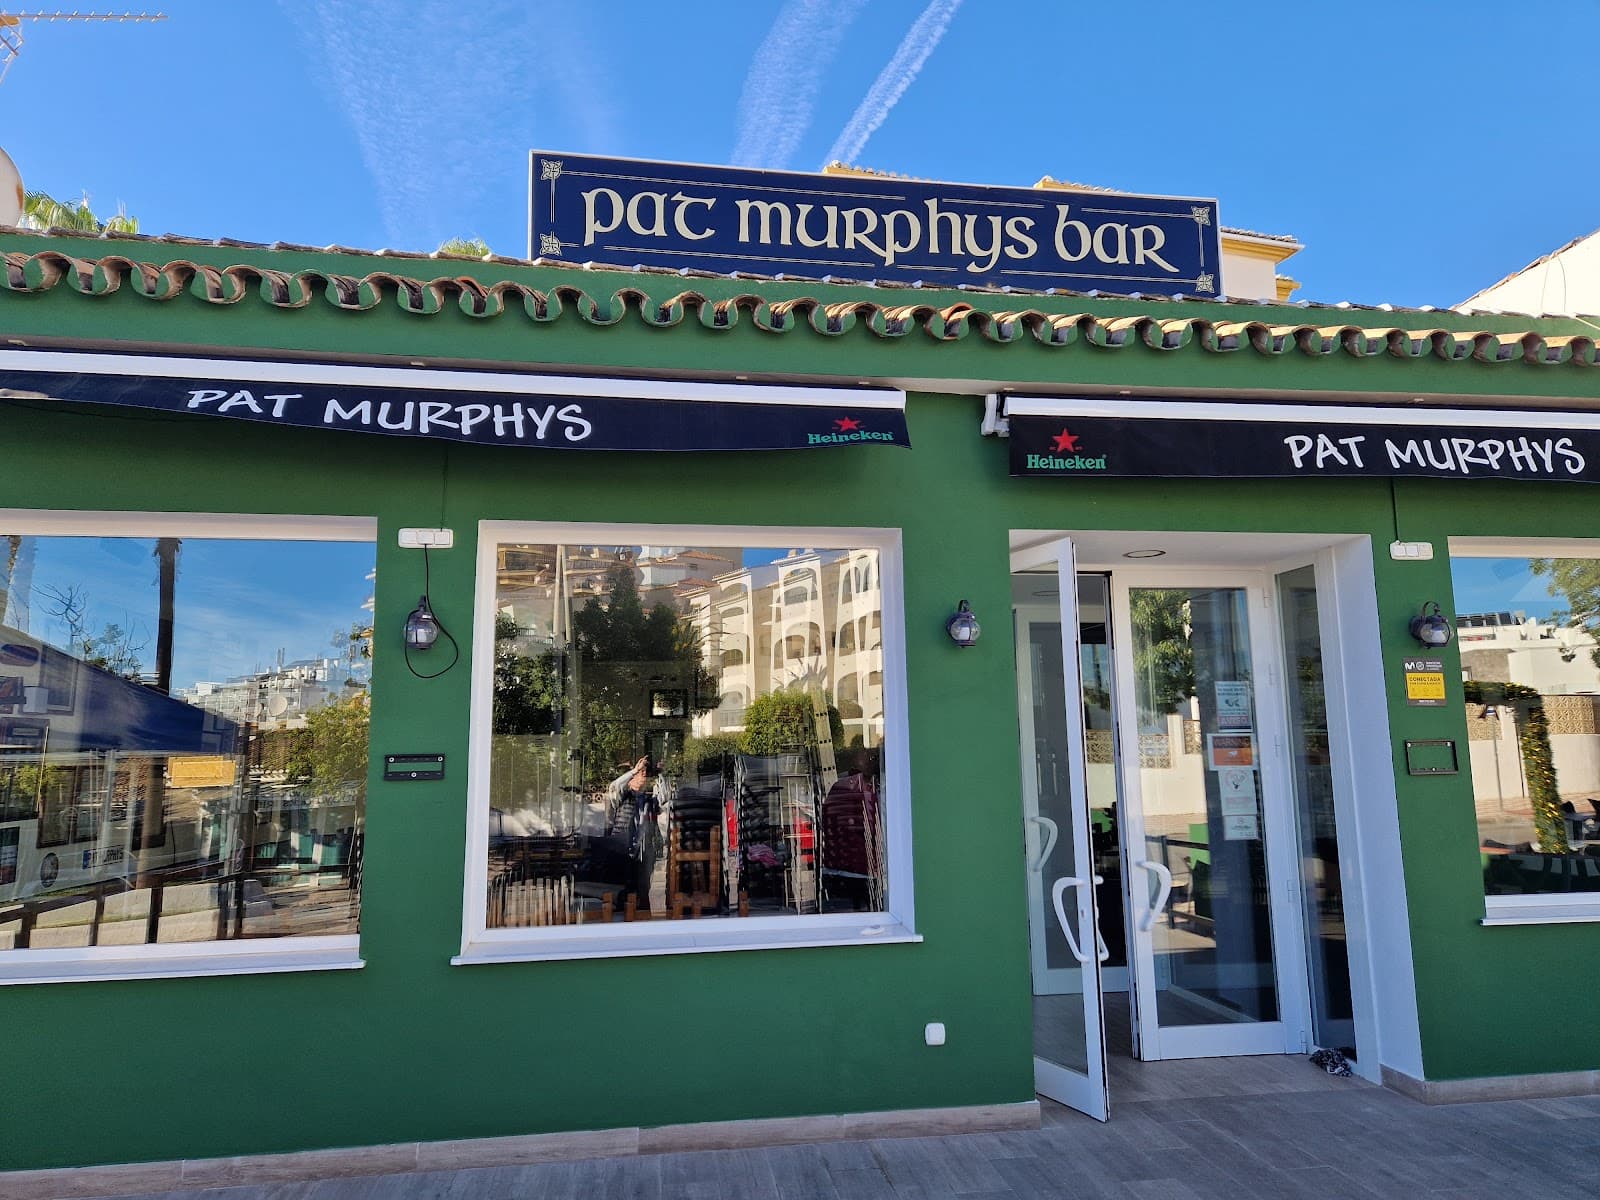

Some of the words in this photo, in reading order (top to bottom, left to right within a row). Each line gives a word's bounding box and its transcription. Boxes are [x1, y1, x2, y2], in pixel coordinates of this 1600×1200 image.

[187, 389, 302, 418] PAT
[323, 399, 592, 441] MURPHYS
[808, 430, 894, 444] Heineken
[1026, 454, 1106, 469] Heineken
[1284, 433, 1365, 468] PAT
[1384, 437, 1586, 474] MURPHYS
